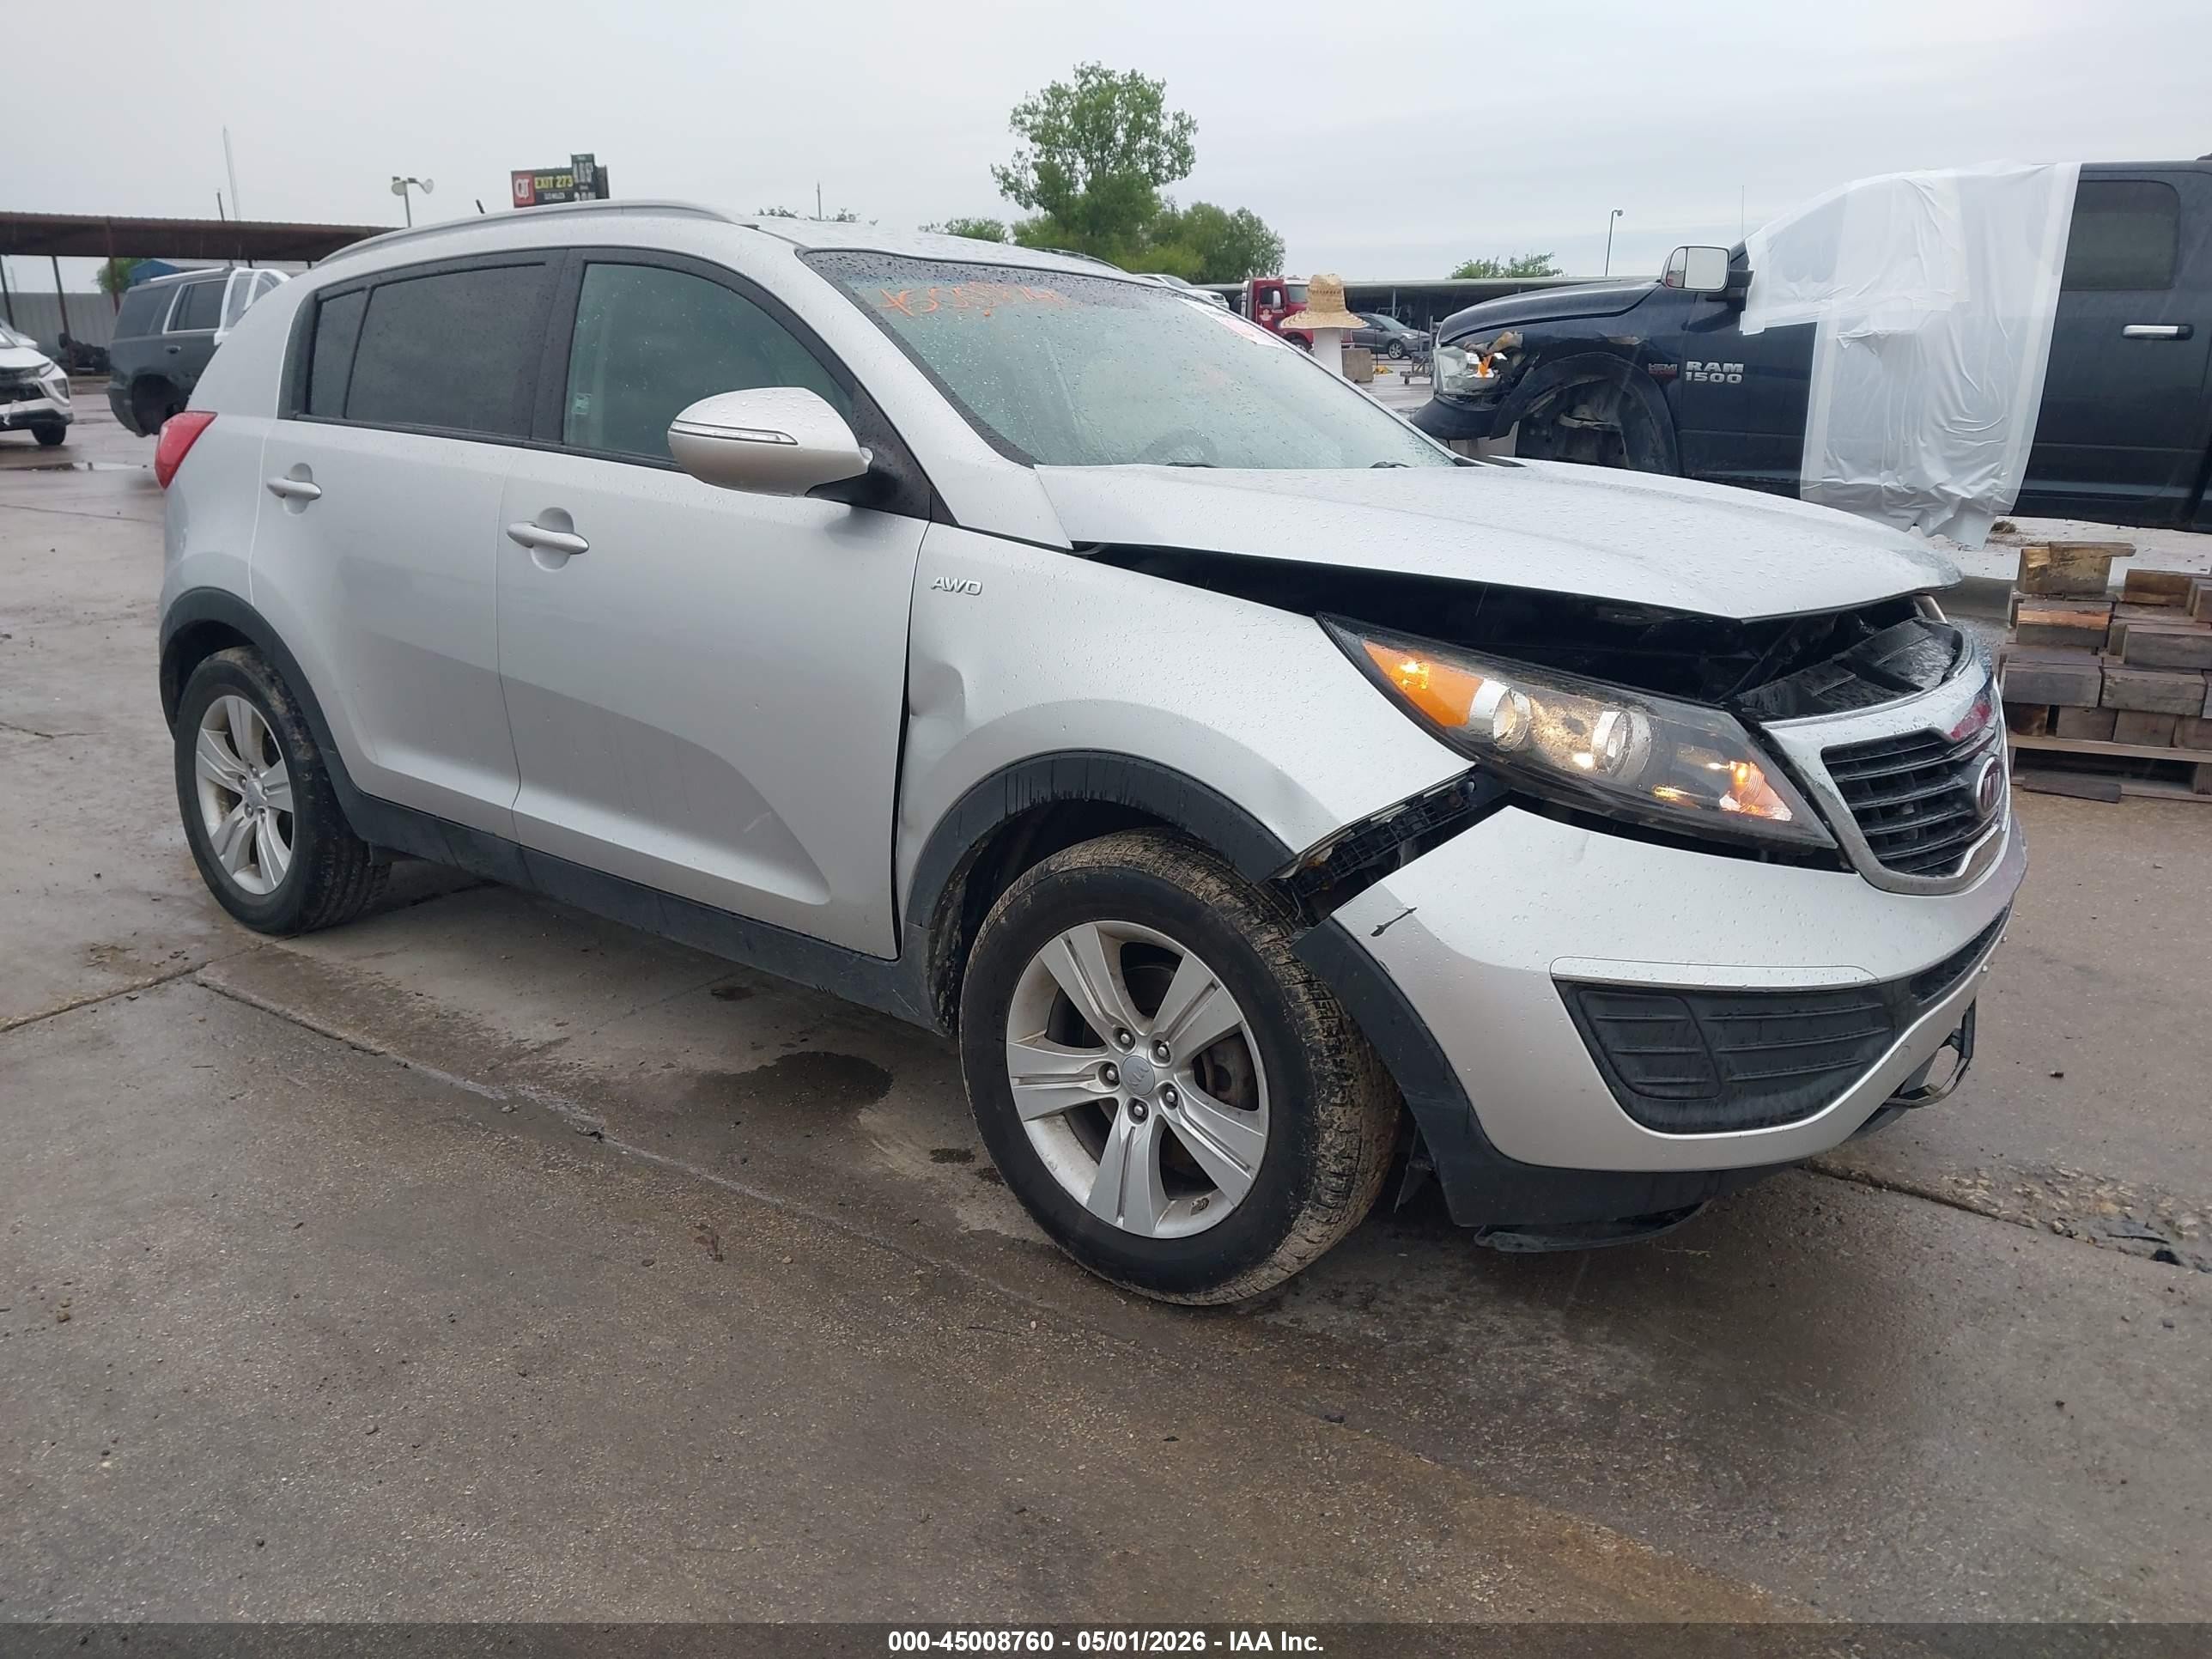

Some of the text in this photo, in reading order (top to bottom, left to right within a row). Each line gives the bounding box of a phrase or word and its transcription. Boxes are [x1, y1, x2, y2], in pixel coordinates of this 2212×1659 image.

[534, 174, 574, 189] EXIT 273
[1686, 361, 1744, 373] RAM
[1686, 372, 1742, 384] 1500
[931, 576, 982, 596] AWD
